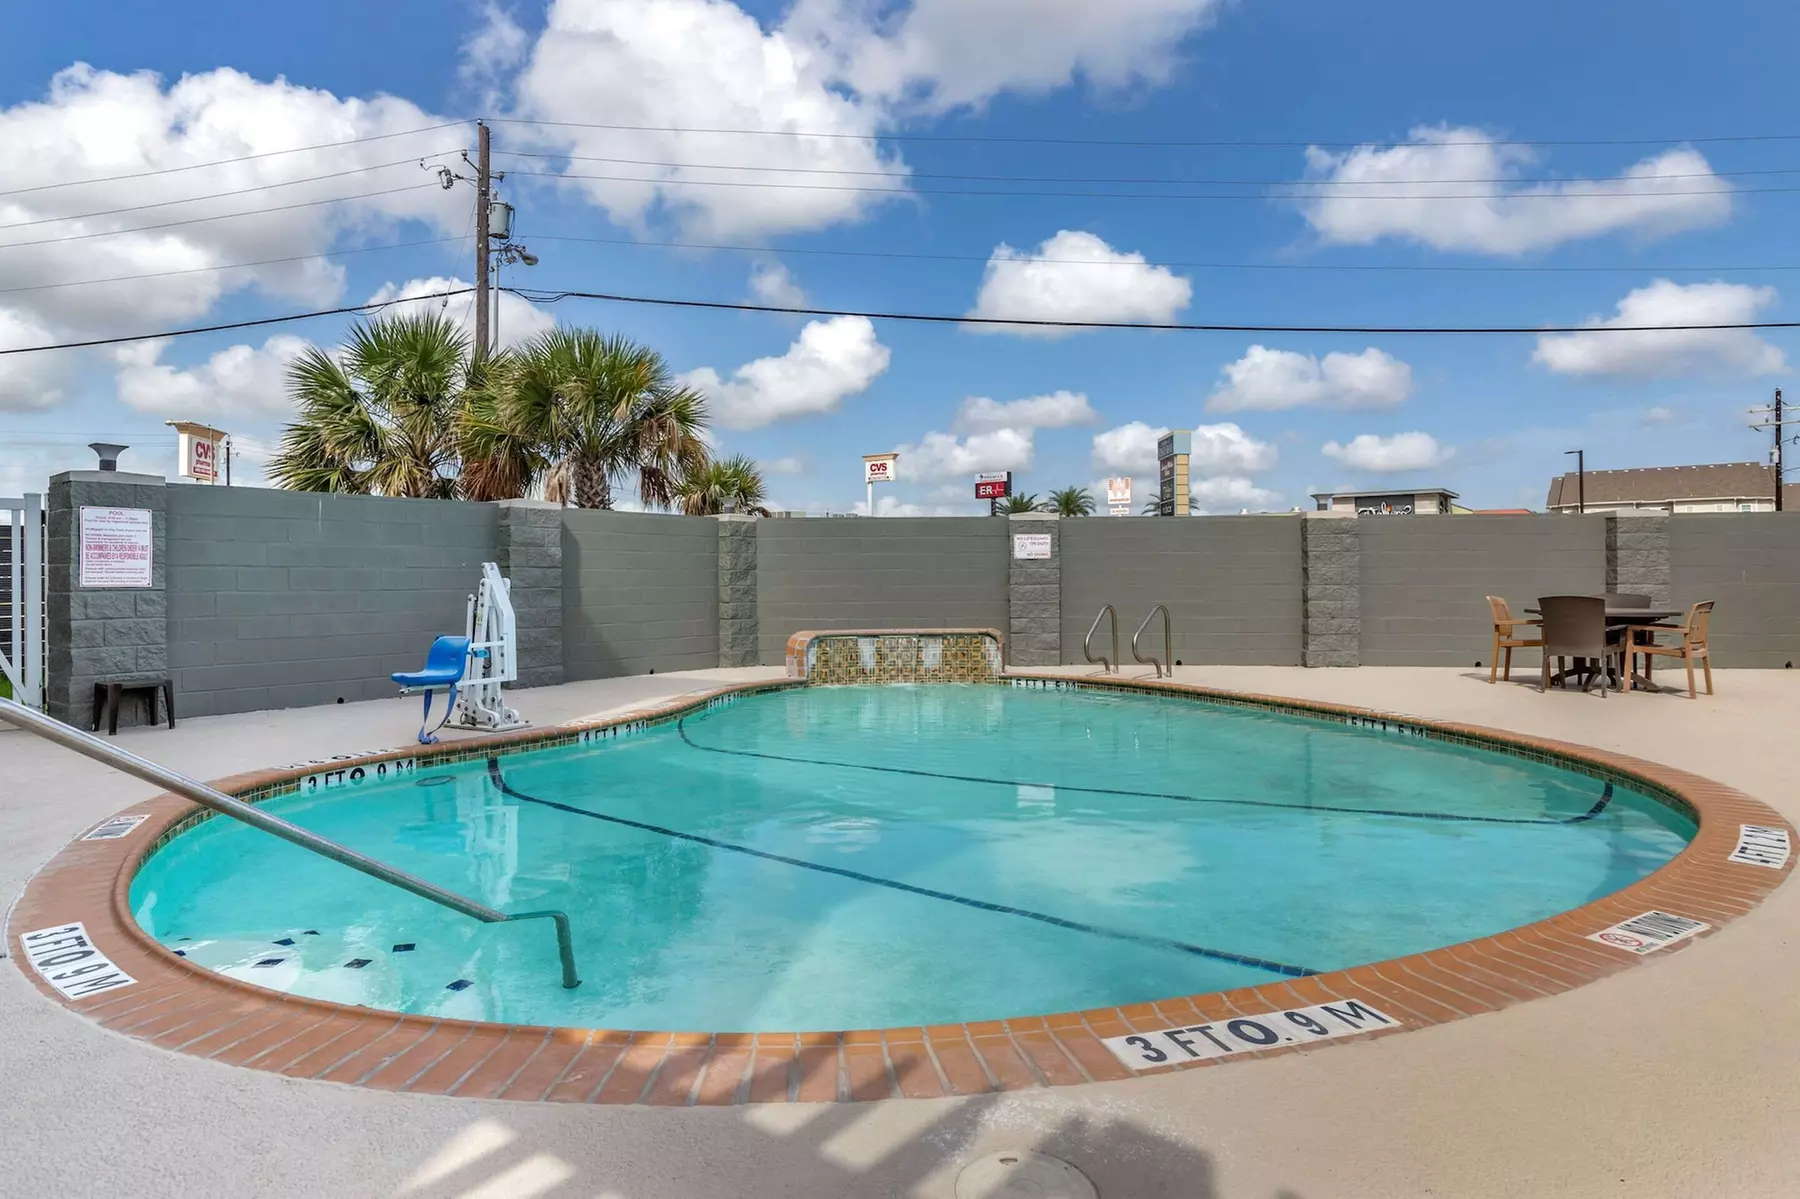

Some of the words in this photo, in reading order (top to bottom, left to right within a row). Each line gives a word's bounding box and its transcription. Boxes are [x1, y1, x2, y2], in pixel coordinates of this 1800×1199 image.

[870, 463, 887, 472] CVS
[980, 485, 993, 495] ER
[26, 926, 80, 940] 3
[28, 935, 88, 956] FT
[63, 973, 130, 996] M
[1125, 1035, 1168, 1063] 3
[1163, 1025, 1233, 1058] FT
[1320, 1000, 1391, 1029] M
